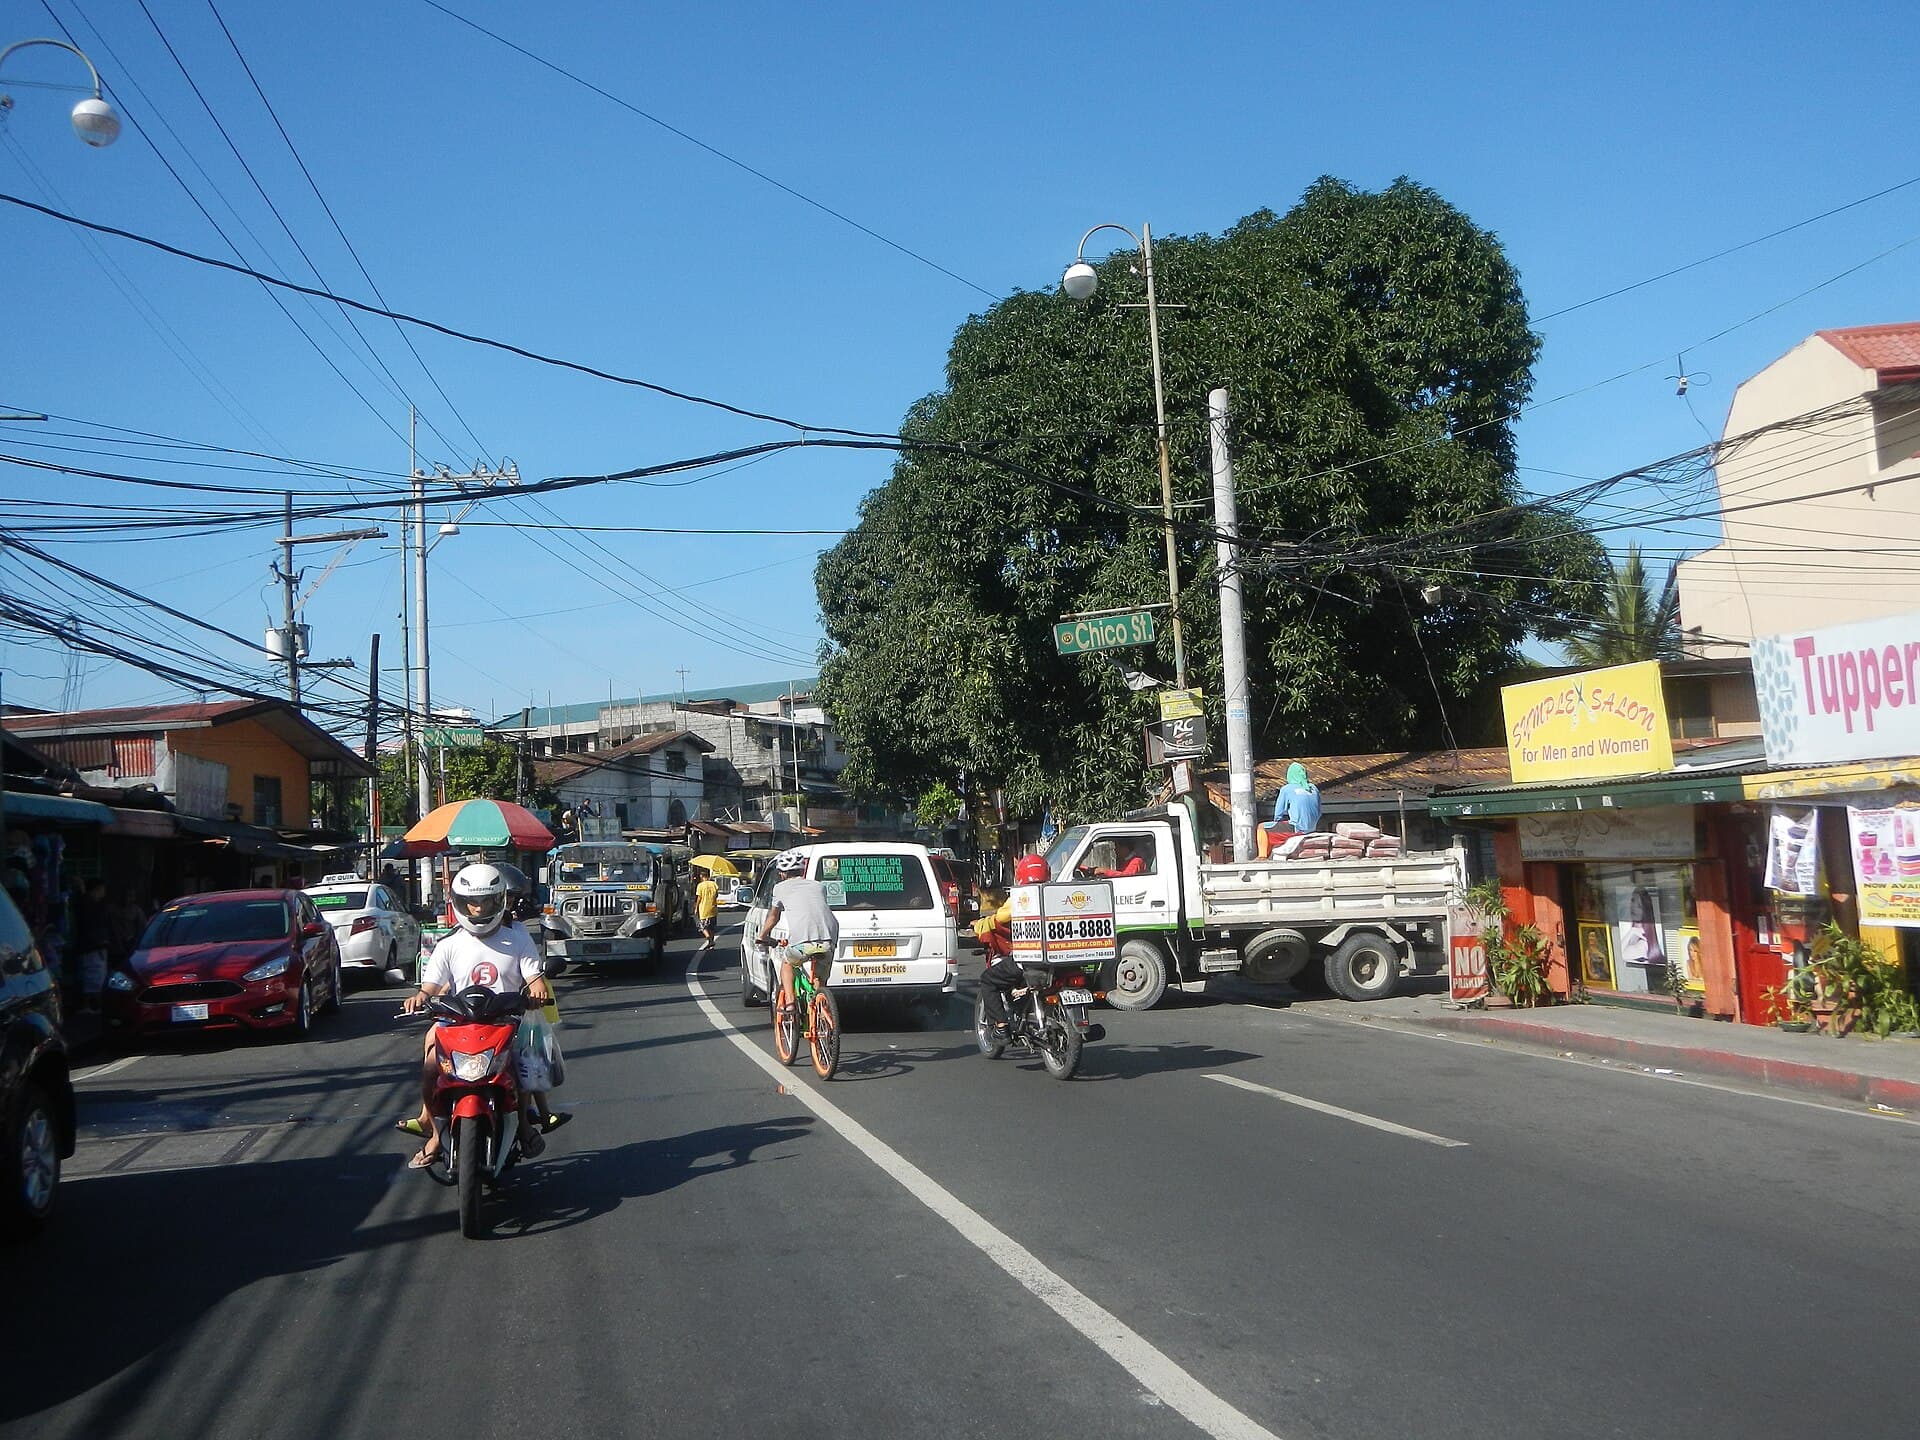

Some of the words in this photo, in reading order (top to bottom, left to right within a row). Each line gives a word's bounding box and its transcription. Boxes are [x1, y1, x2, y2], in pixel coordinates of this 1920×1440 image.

[1075, 620, 1128, 650] Chico
[1131, 614, 1152, 642] St.
[1793, 635, 1920, 734] Tupper
[1172, 717, 1194, 737] RC
[451, 730, 482, 747] Avenue
[1522, 747, 1539, 763] for
[1542, 744, 1567, 761] Men
[1571, 740, 1595, 758] and
[1598, 737, 1650, 755] Women
[1064, 895, 1092, 905] AMBER
[1048, 919, 1112, 940] 884-8888
[844, 964, 854, 975] UV
[856, 964, 881, 976] Express
[882, 963, 907, 973] Service
[1454, 945, 1486, 976] NO
[1452, 976, 1487, 990] PARKIN
